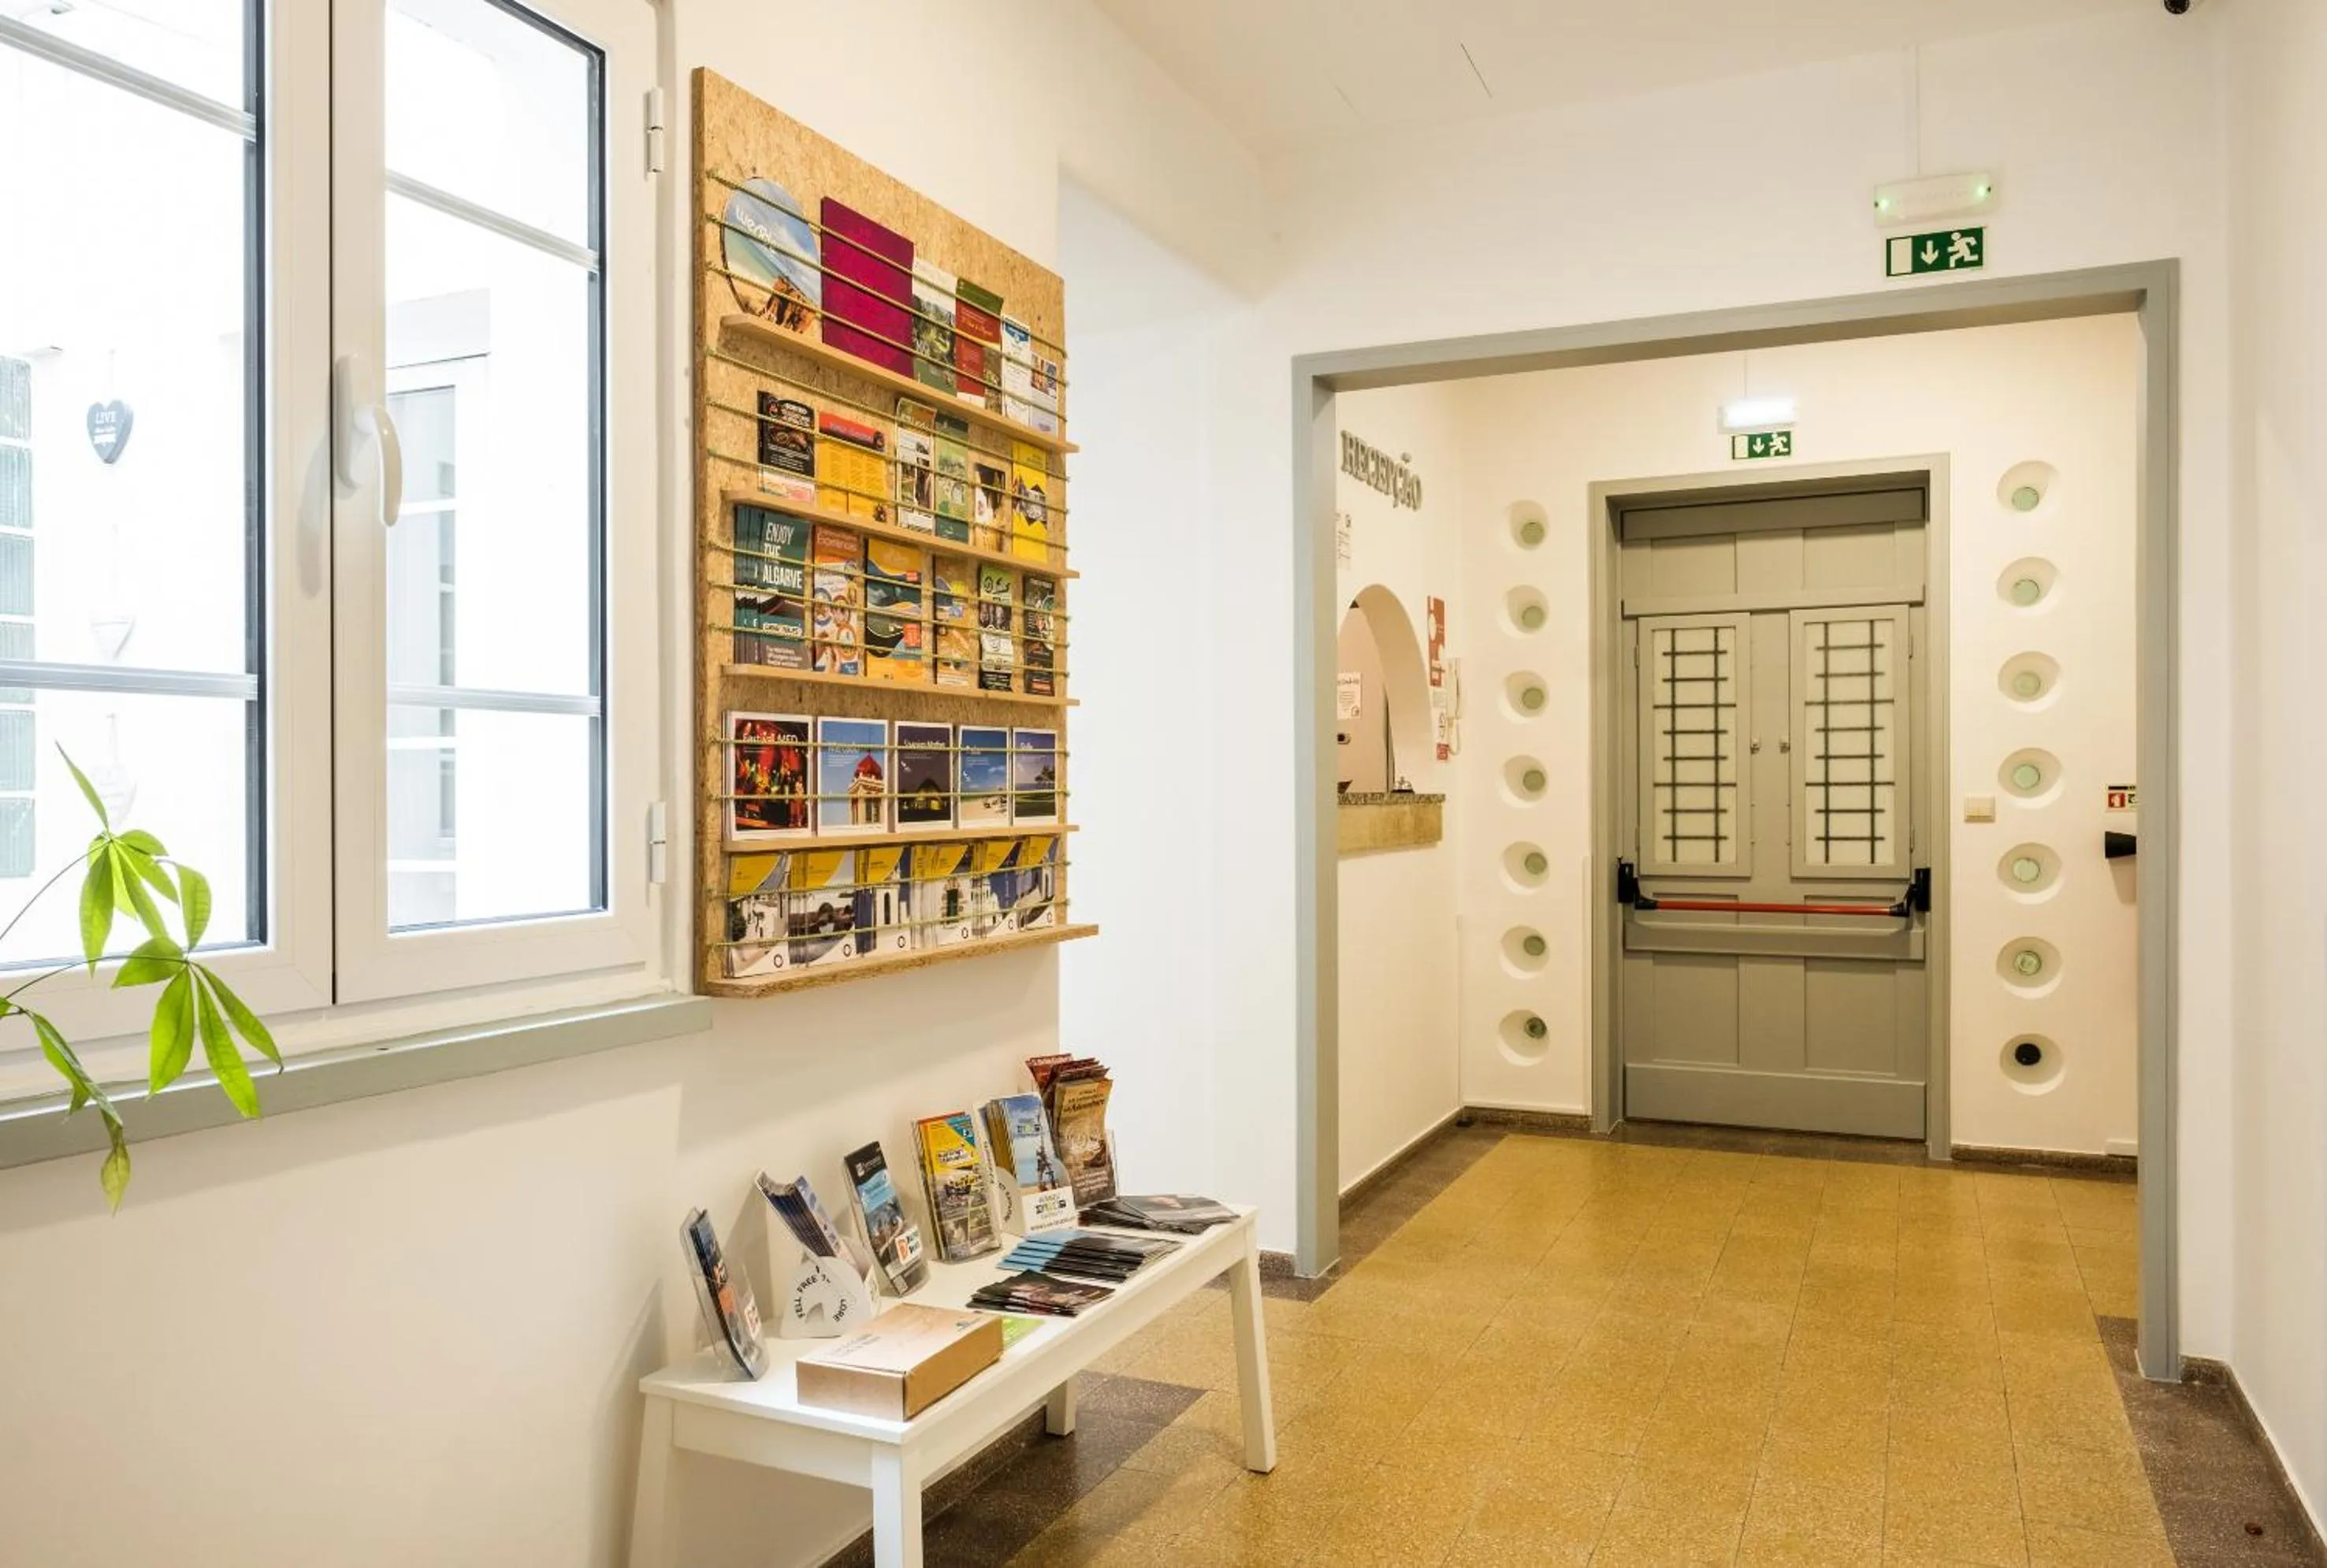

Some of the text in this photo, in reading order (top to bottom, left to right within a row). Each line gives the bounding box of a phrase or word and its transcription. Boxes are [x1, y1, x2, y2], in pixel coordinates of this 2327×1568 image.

[1340, 429, 1422, 512] RECEPÇÃO
[766, 522, 795, 545] ENJOY
[762, 563, 803, 589] ALGARVE
